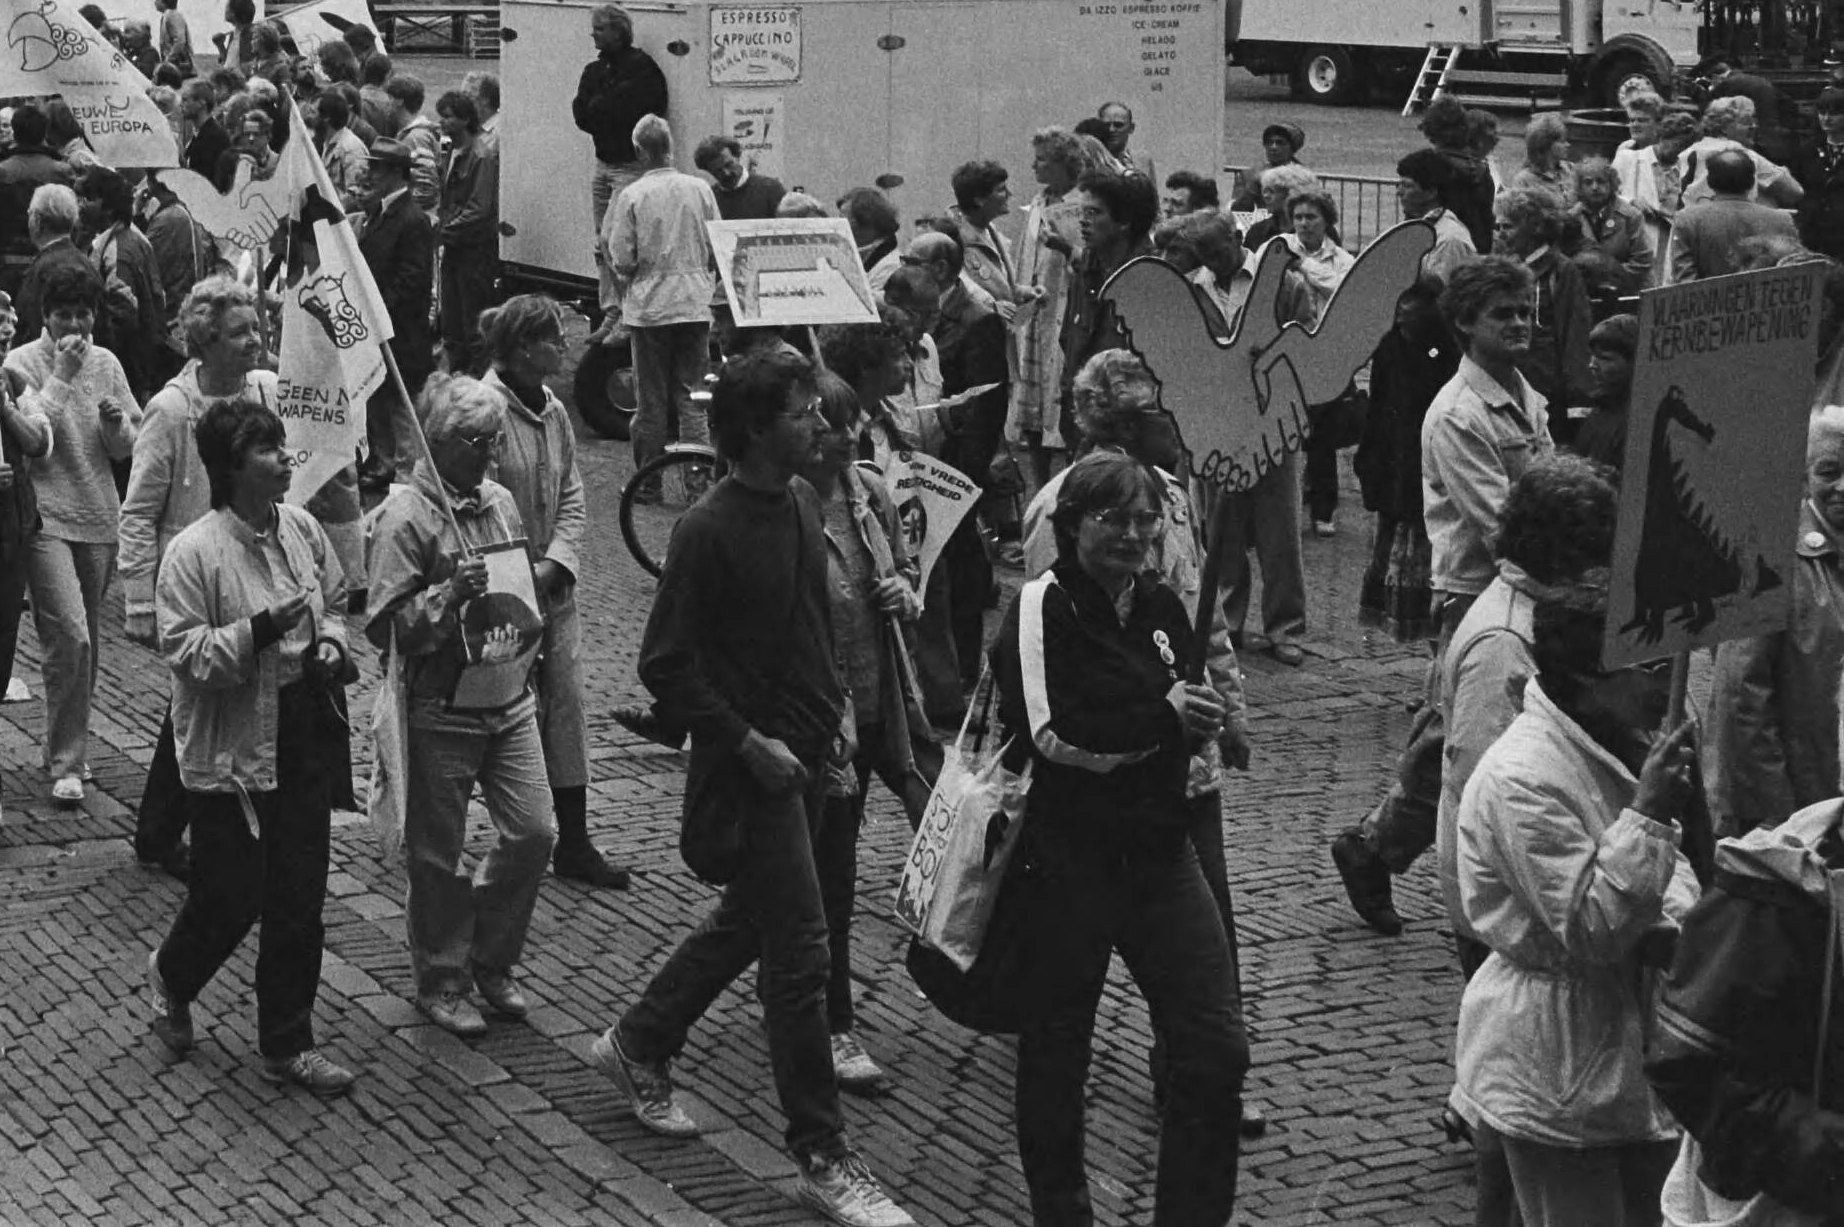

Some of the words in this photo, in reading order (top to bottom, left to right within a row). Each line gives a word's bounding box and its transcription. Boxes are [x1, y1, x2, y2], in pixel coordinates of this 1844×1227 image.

[1122, 4, 1167, 14] ESPRESSO
[1170, 3, 1200, 13] KOFFIE
[721, 11, 787, 24] ESPRESSO
[714, 32, 793, 48] CAPPUCCINO
[1141, 35, 1176, 45] HELADO
[1141, 52, 1176, 61] GELATO
[91, 120, 154, 134] EUROPA
[1653, 282, 1754, 325] VLAARDINGEN
[1760, 274, 1812, 308] TEGEN
[1648, 303, 1812, 363] KERNBEWAPENING
[276, 378, 329, 404] GEEN
[277, 403, 345, 425] WAPENS
[930, 467, 975, 496] VREDE
